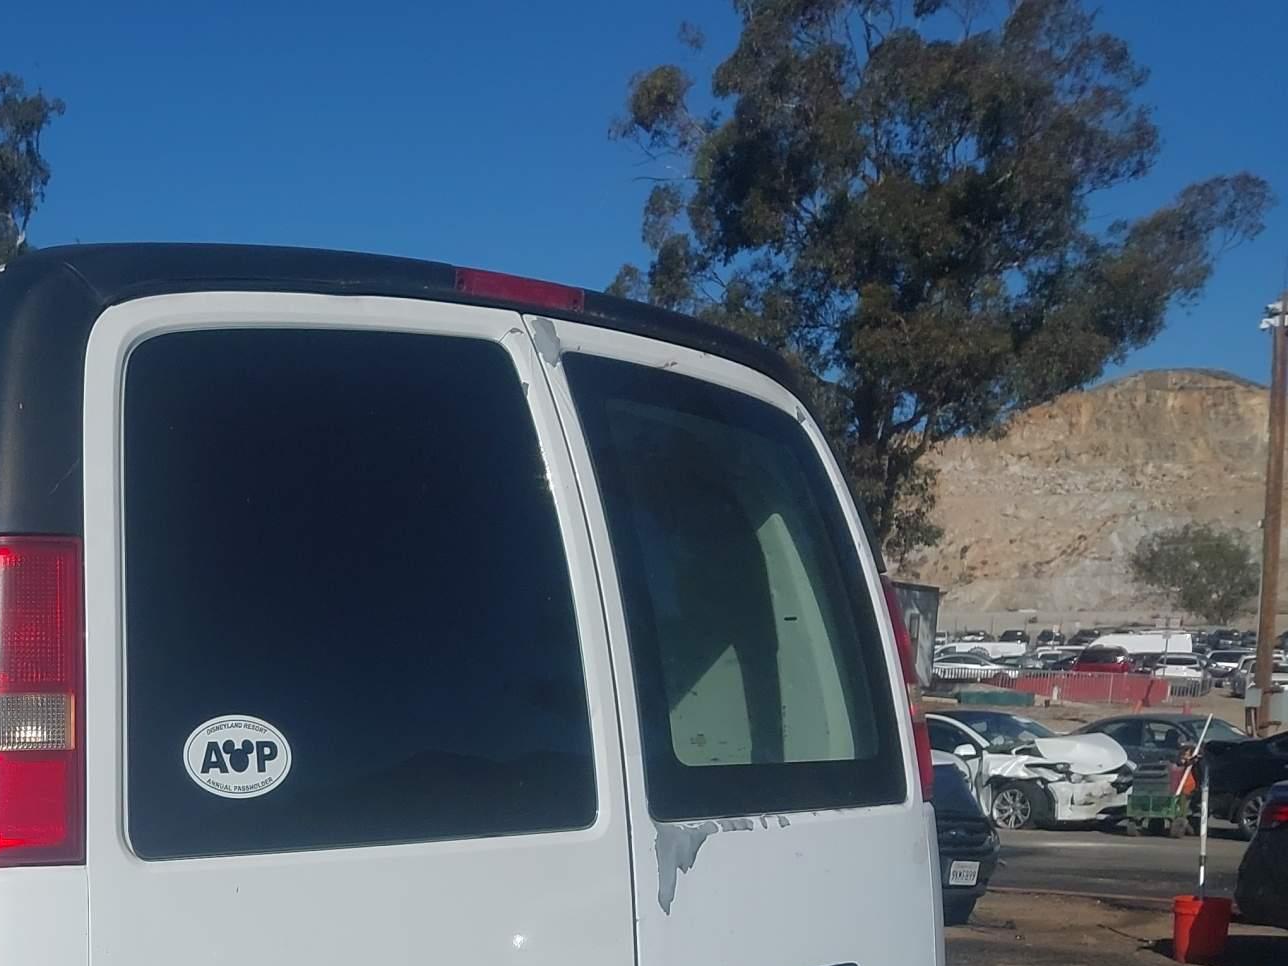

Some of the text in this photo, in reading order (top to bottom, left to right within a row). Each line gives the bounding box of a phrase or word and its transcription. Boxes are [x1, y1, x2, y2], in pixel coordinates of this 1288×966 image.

[206, 723, 268, 735] DISNEYLAND RESORT
[207, 777, 273, 791] ANNUAL PASSHOLDER
